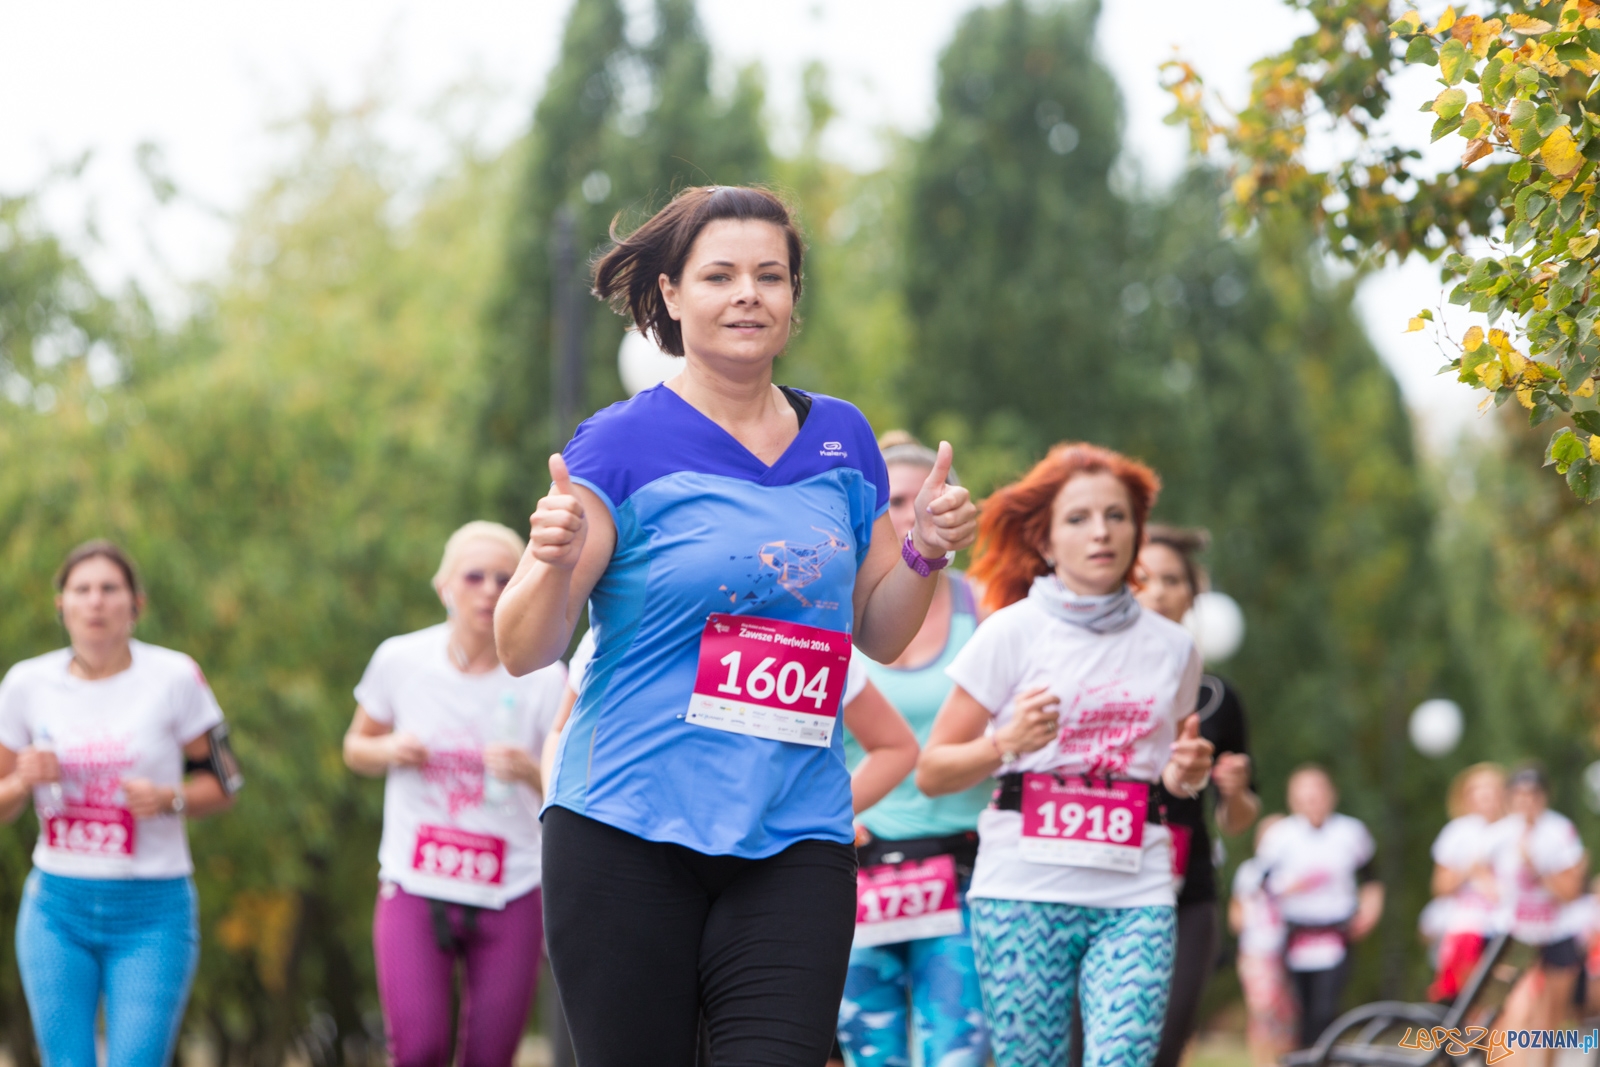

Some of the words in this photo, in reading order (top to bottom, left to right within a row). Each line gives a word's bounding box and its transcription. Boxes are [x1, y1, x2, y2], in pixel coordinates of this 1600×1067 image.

[738, 628, 773, 642] Zawsze
[774, 633, 811, 649] Pier(w)si
[810, 640, 830, 652] 2016
[717, 650, 830, 709] 1604
[51, 819, 128, 853] 1622
[1036, 801, 1134, 843] 1918
[418, 841, 500, 882] 1919
[860, 879, 947, 923] 1737
